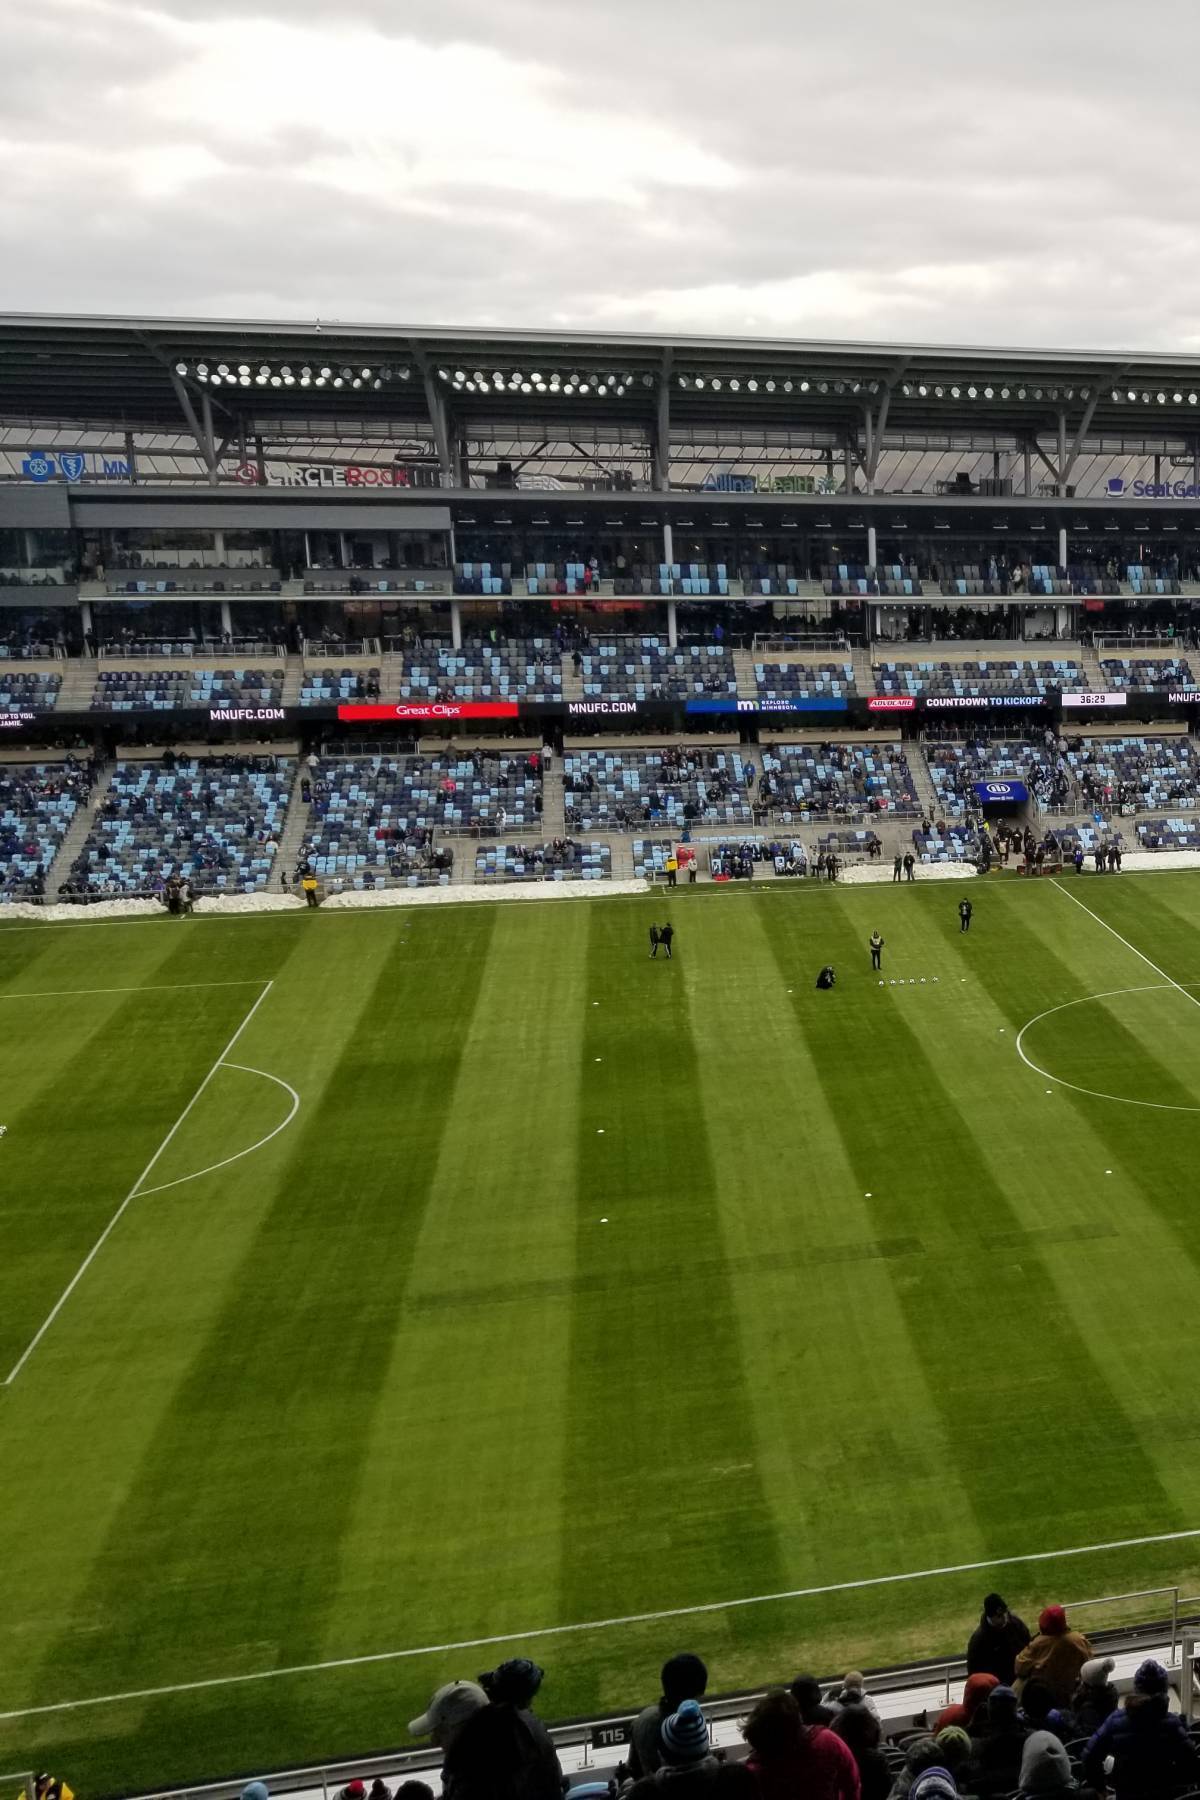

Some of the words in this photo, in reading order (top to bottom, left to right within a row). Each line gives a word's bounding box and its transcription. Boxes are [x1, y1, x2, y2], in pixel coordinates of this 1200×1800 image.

[104, 461, 132, 476] MN
[756, 474, 815, 493] Health
[926, 697, 988, 707] COUNTDOWN
[990, 697, 1001, 705] TO
[1080, 695, 1106, 704] 36:29
[396, 705, 429, 716] Great
[432, 704, 460, 716] Clips
[568, 702, 637, 714] MNUFC.COM
[210, 708, 285, 721] MNUFC.COM
[599, 1728, 625, 1744] 115
